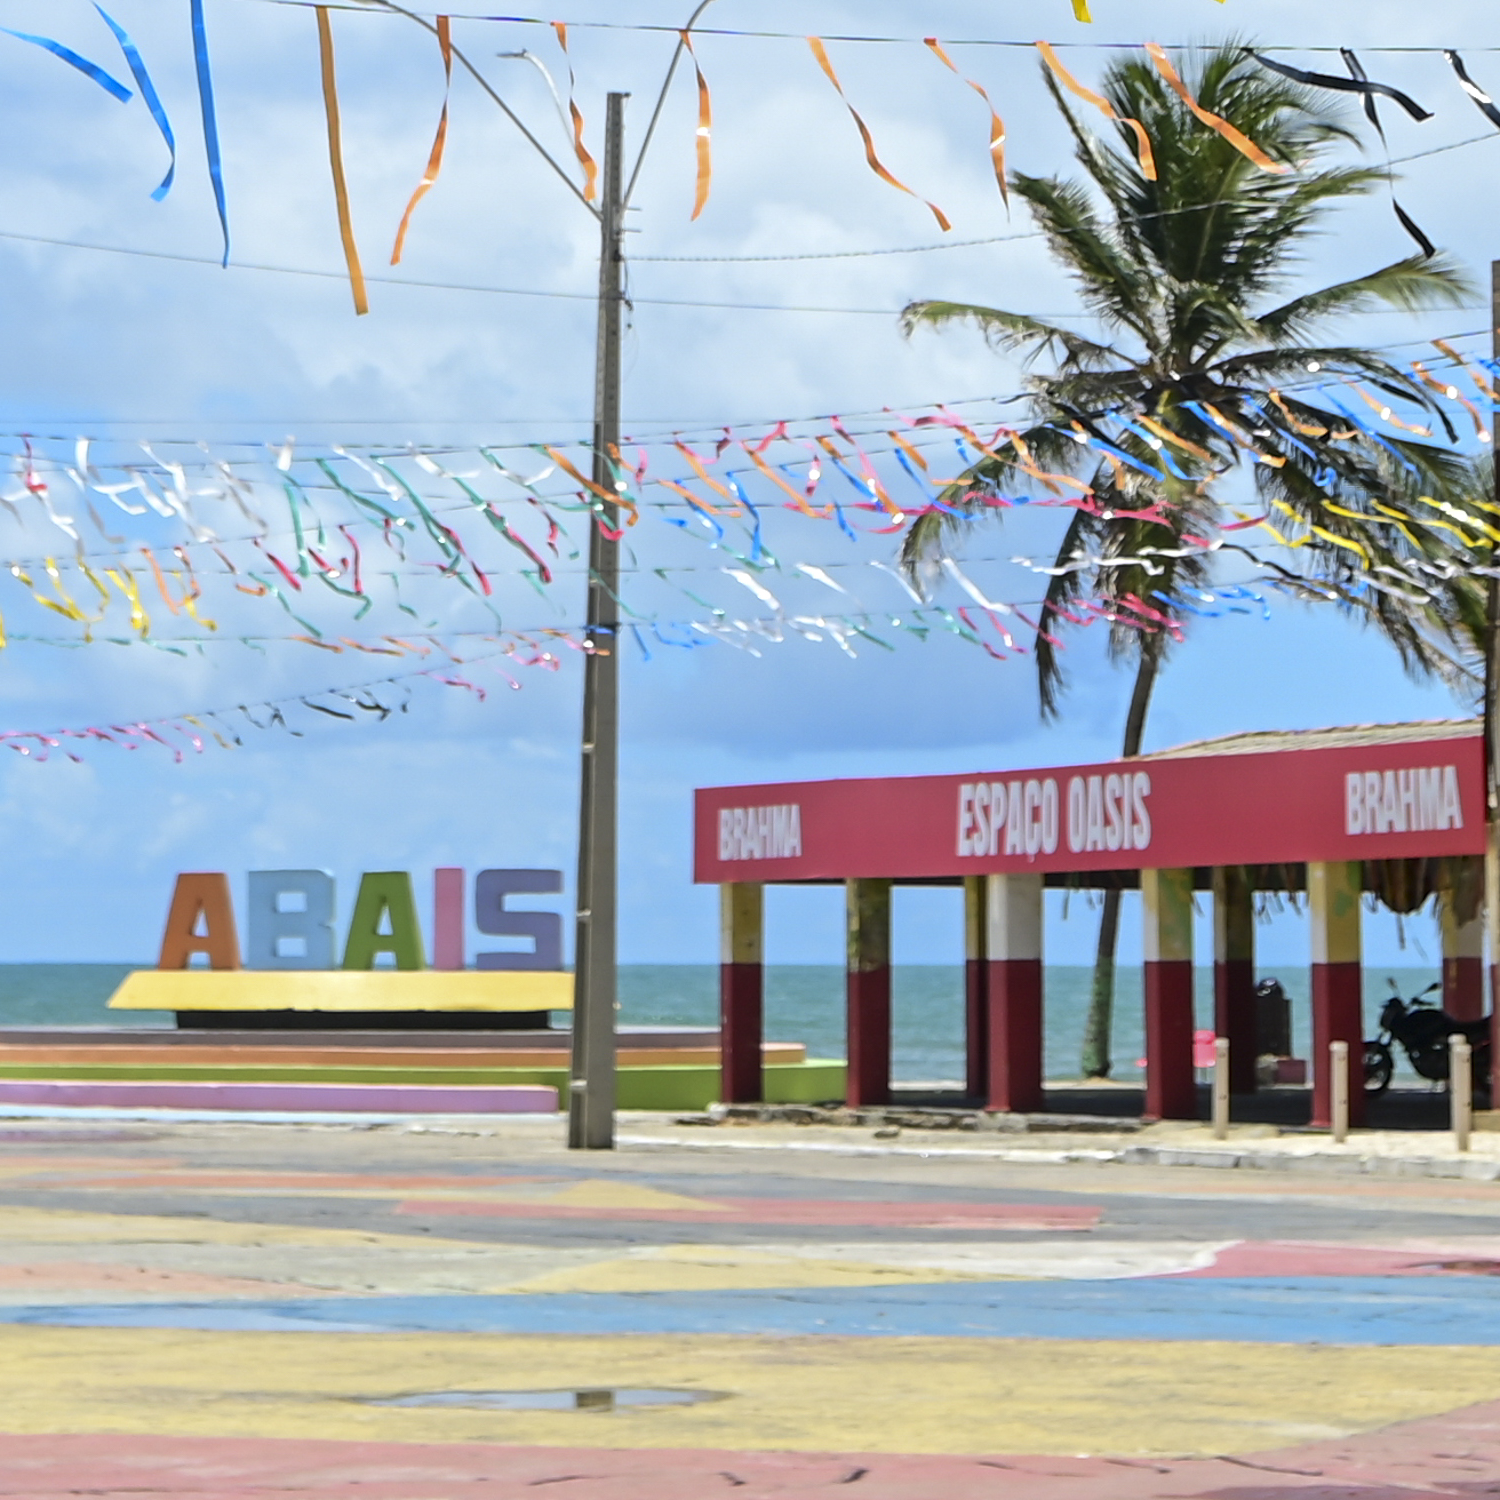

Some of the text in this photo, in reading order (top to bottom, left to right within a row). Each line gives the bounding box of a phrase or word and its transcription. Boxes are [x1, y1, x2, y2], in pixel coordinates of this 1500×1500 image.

[718, 804, 801, 861] BRAHMA
[957, 771, 1151, 863] ESPAÇO OASIS
[1345, 764, 1463, 835] BRAHMA
[158, 867, 564, 971] ABAIS
